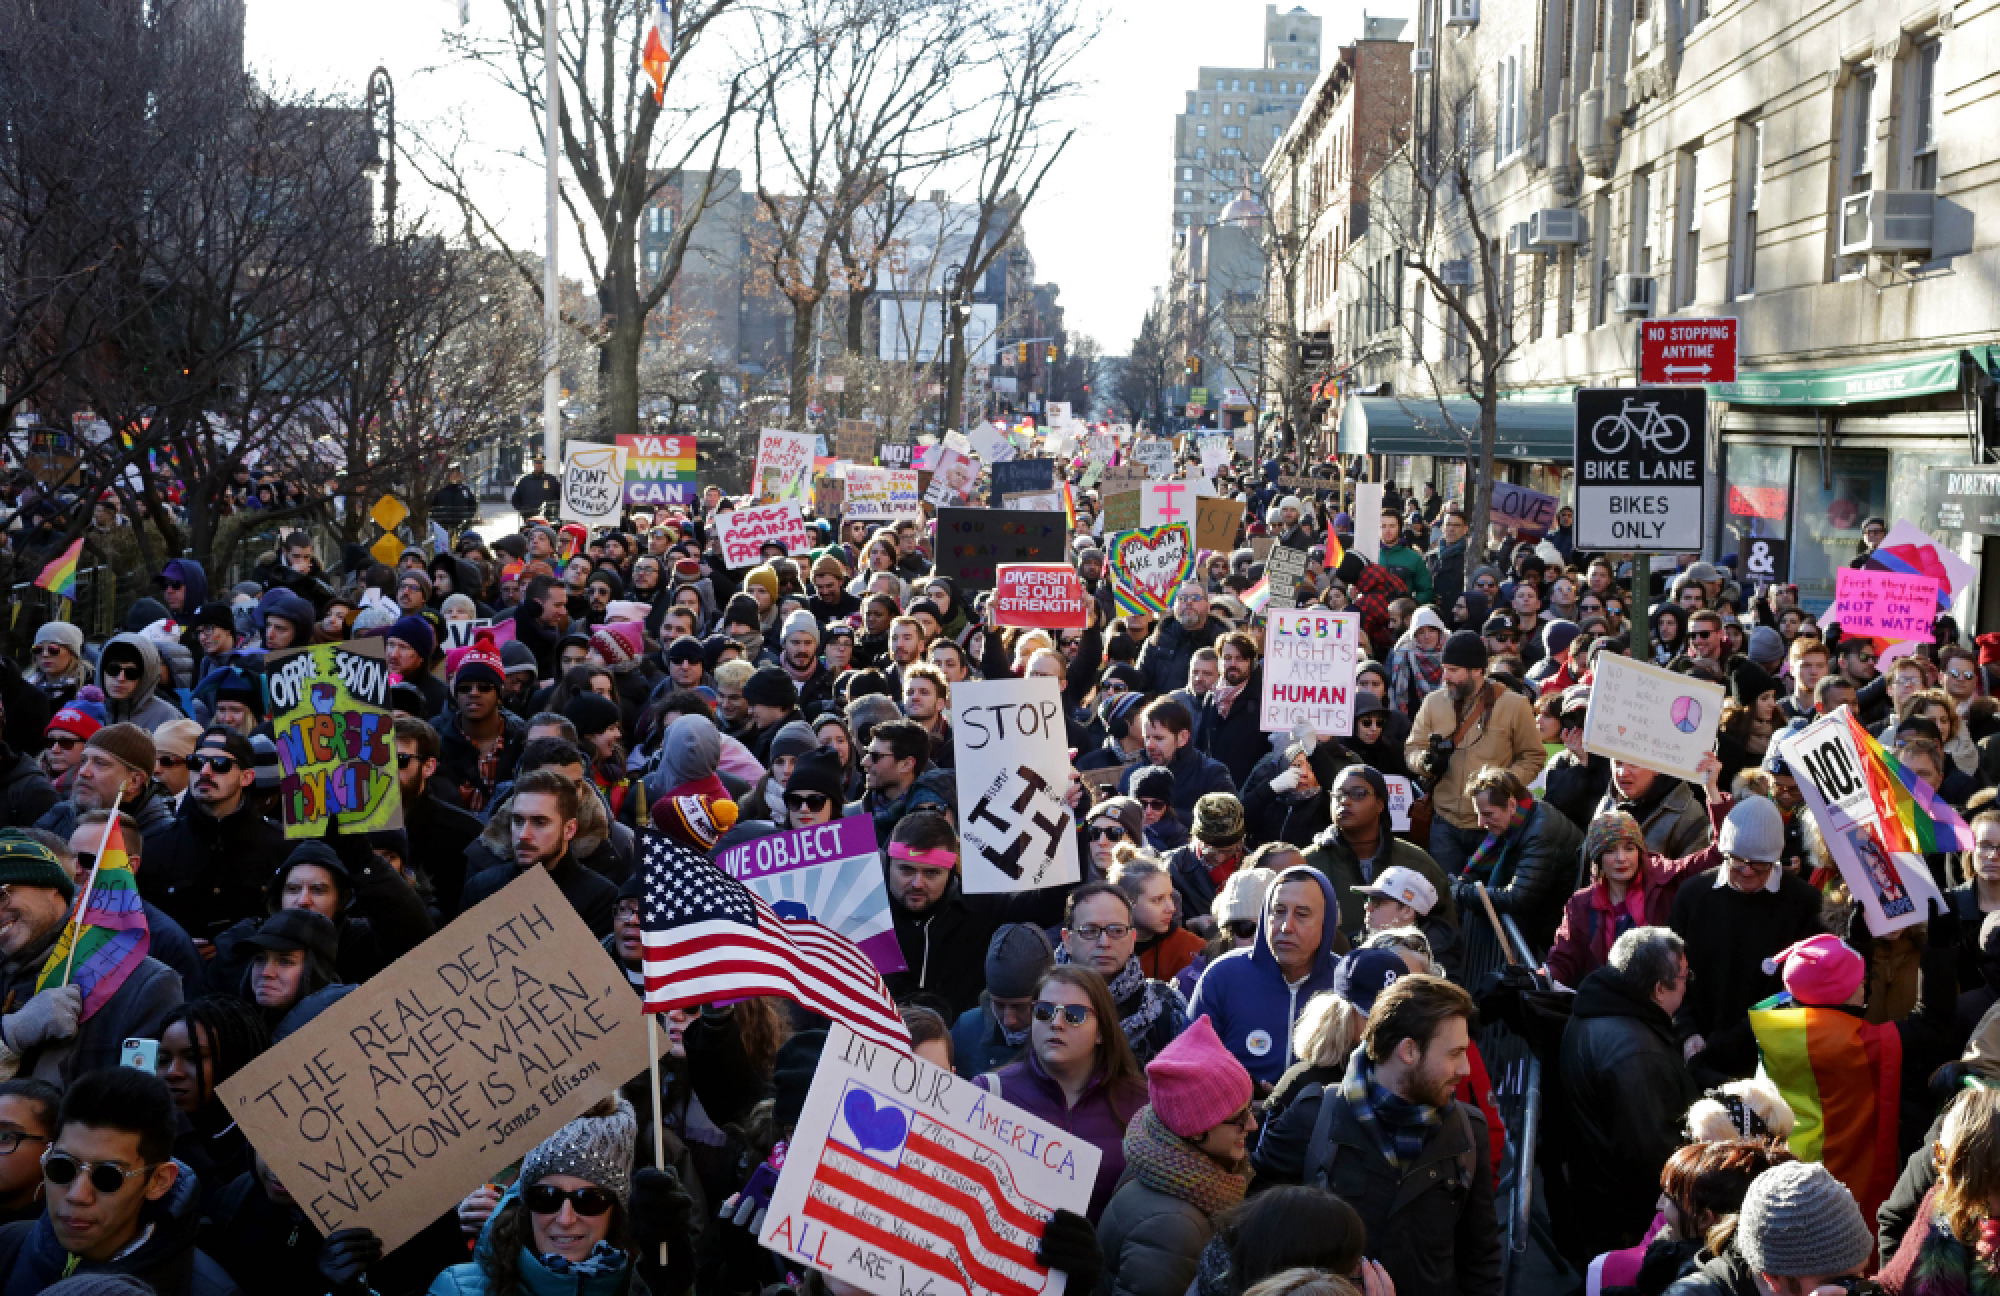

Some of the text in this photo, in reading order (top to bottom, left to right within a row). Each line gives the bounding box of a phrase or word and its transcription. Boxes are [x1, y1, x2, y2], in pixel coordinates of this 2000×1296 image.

[1648, 326, 1729, 340] NO STOPPING
[1662, 344, 1715, 358] ANYTIME
[633, 437, 681, 456] YAS
[881, 444, 911, 462] NO!
[636, 461, 678, 479] WE
[1583, 460, 1696, 479] BIKE LANE
[570, 484, 608, 498] FUCK
[629, 483, 682, 502] CAN
[1609, 496, 1669, 514] BIKES
[732, 507, 789, 526] FAGS
[724, 518, 803, 542] AGAINST
[952, 521, 985, 533] YOU
[1611, 521, 1666, 538] ONLY
[728, 534, 808, 563] FASSM
[1748, 542, 1774, 573] &
[1004, 571, 1078, 584] DIVERSITY
[1016, 586, 1067, 598] IS OUR
[1000, 597, 1081, 612] STRENGTH
[1837, 602, 1911, 615] NOT ON
[1278, 617, 1349, 639] LGBT
[1843, 616, 1936, 635] OUR WATCH
[1272, 640, 1353, 663] RIGHTS
[1287, 661, 1331, 683] ARE
[1272, 684, 1347, 704] HUMAN
[961, 701, 1057, 749] STOP
[1267, 706, 1348, 729] RIGHTS
[276, 711, 393, 776] INTERSEC
[1803, 736, 1863, 806] NO!
[725, 823, 843, 877] WE OBJECT
[350, 989, 444, 1059] REAL
[437, 903, 555, 997] DEATH
[299, 965, 543, 1143] OF AMERICA
[298, 970, 589, 1183] WILL BE WHEN
[539, 1060, 601, 1107] Ellison
[838, 1033, 1075, 1180] IN OUR AMERICA
[310, 1094, 482, 1232] EVERYONE
[478, 1071, 516, 1110] IS
[904, 1152, 927, 1172] GAY
[768, 1213, 893, 1280] ALL ARE
